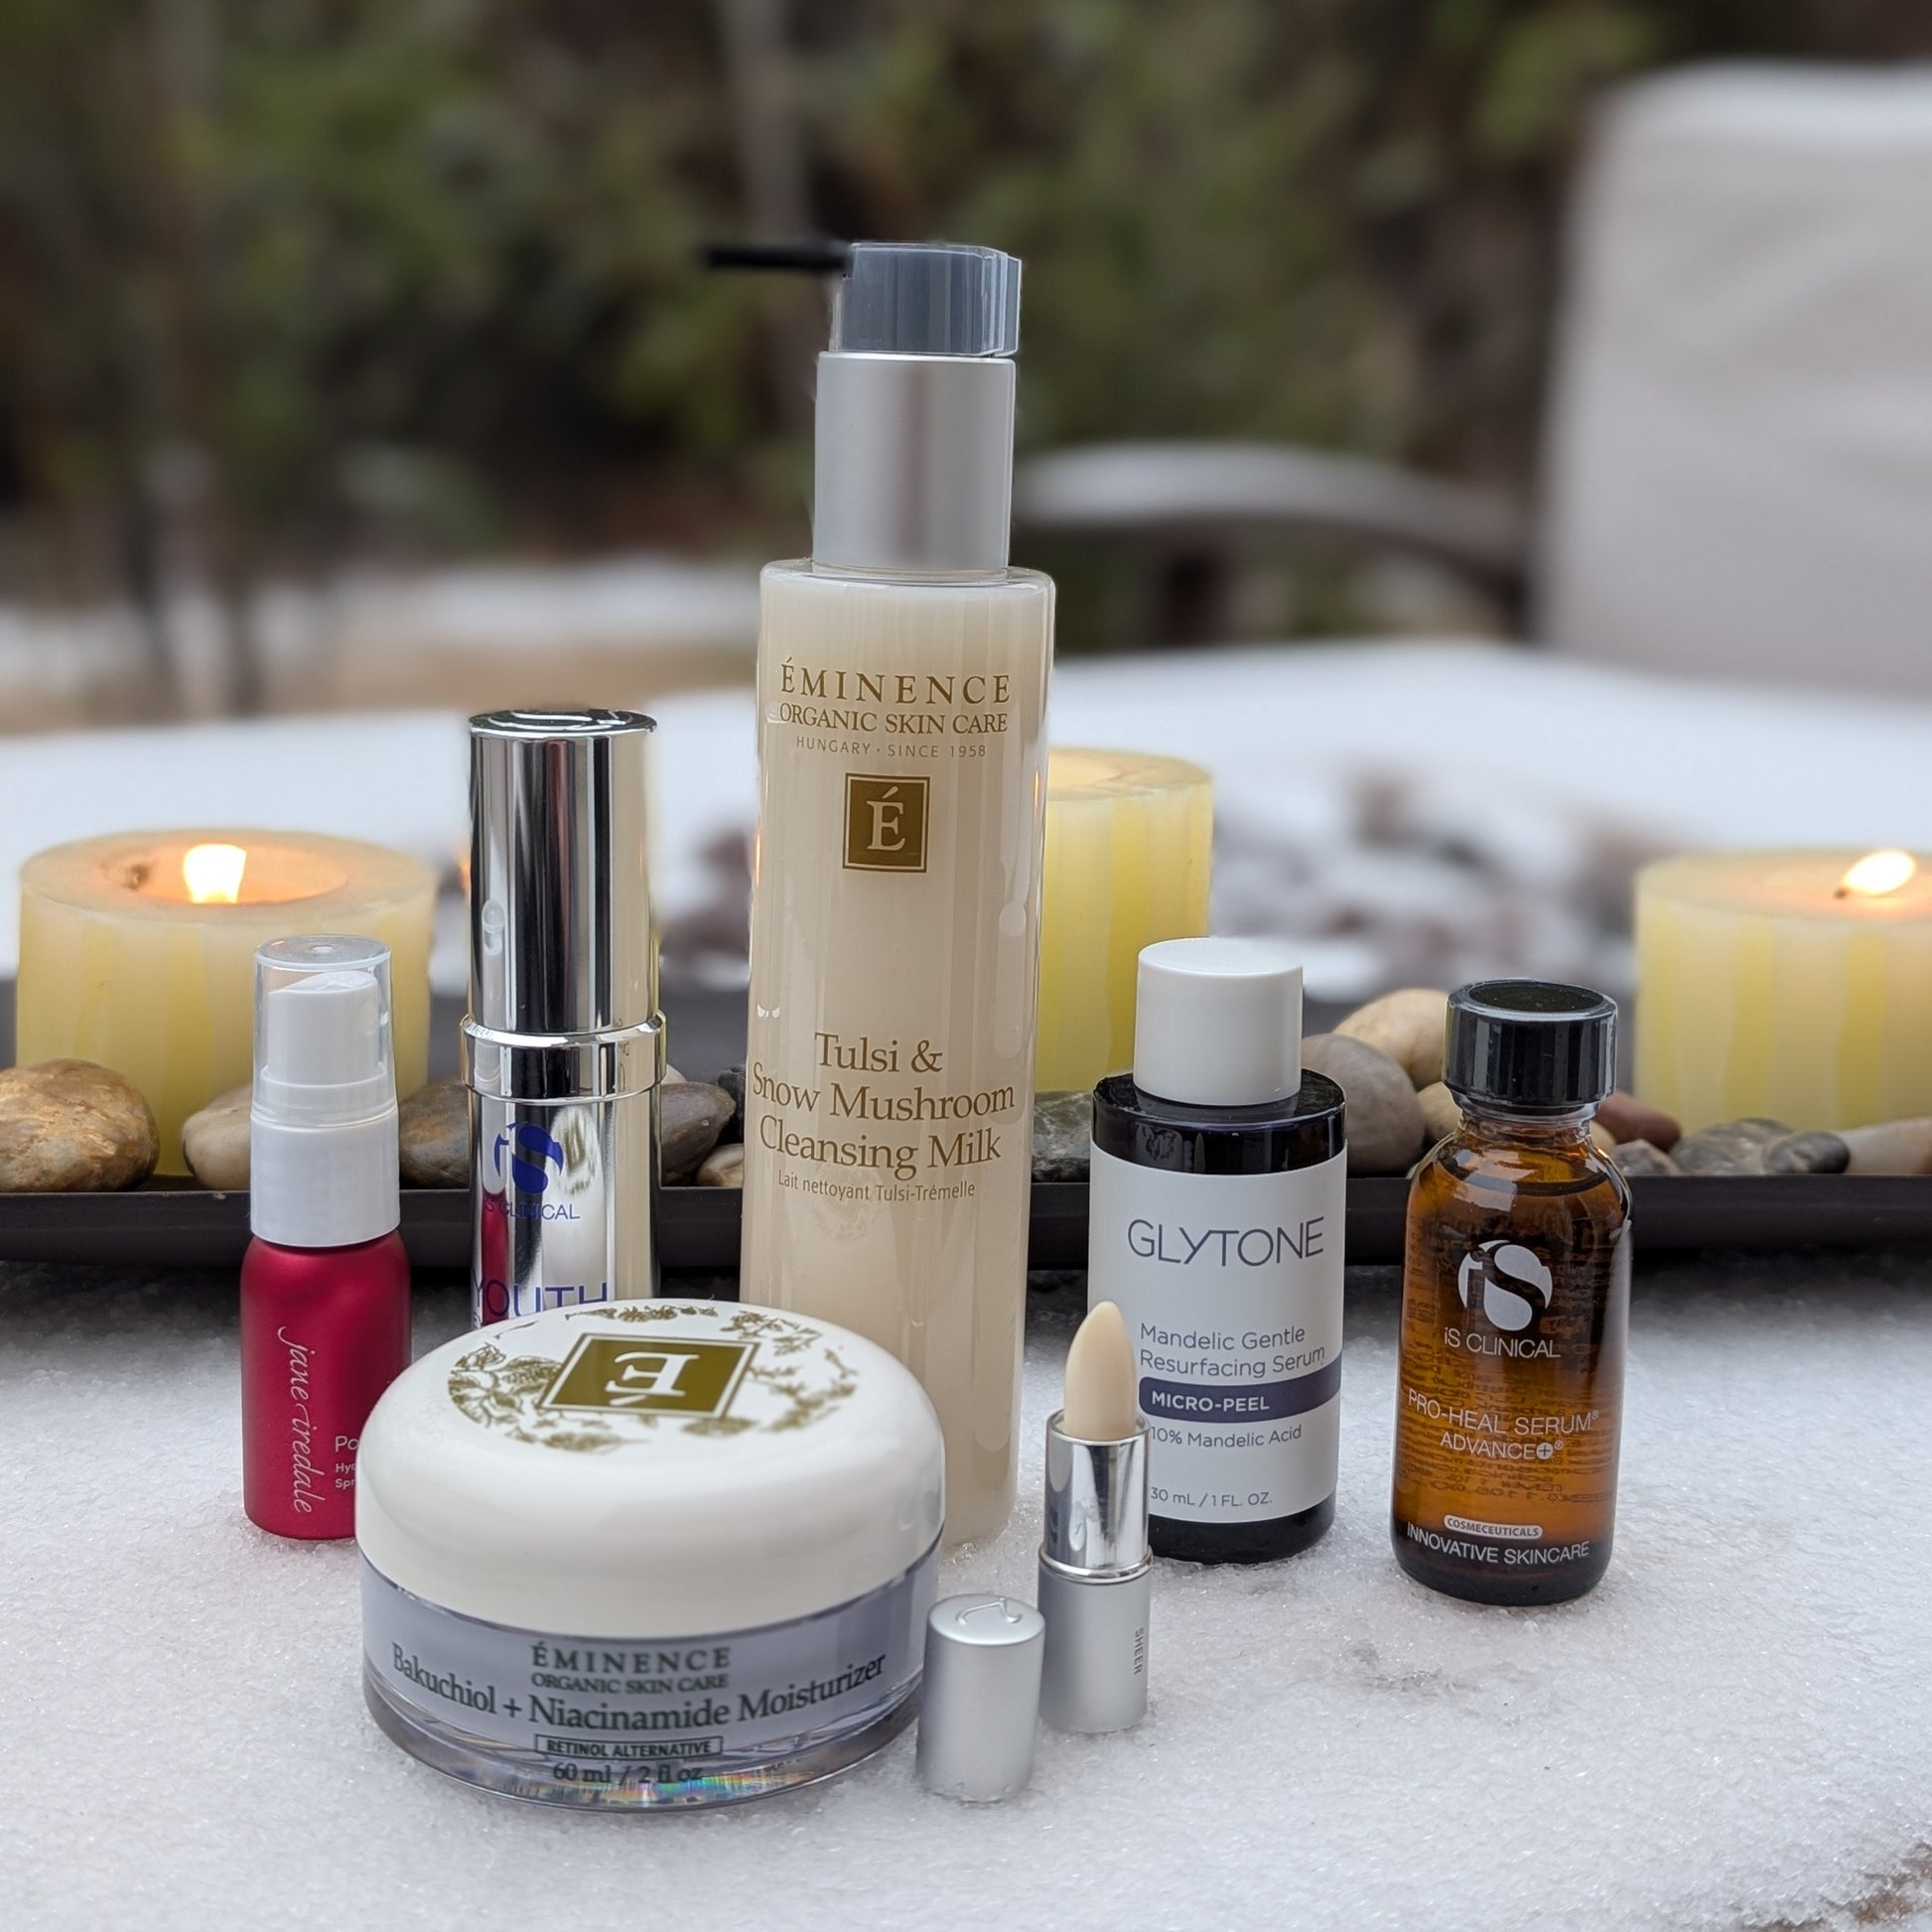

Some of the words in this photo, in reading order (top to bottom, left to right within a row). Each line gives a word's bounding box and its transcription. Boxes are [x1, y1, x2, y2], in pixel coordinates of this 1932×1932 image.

[780, 656, 1011, 704] ÉMINENCE
[779, 702, 878, 732] ORGANIC
[885, 713, 946, 735] SKIN
[952, 713, 1008, 735] CARE
[796, 735, 871, 755] HUNGARY
[888, 745, 938, 758] SINCE
[950, 745, 986, 758] 1958
[866, 785, 906, 852] É
[814, 1032, 900, 1072] Tulsi
[910, 1039, 943, 1073] &
[753, 1061, 821, 1112] Snow
[830, 1082, 1016, 1121] Mushroom
[759, 1115, 918, 1180] Cleansing
[926, 1127, 1002, 1168] Milk
[778, 1169, 799, 1189] Lait
[803, 1177, 870, 1201] nettoyant
[876, 1180, 976, 1202] Tulsi-Trémelle
[1128, 1216, 1324, 1267] GLYTONE
[1141, 1322, 1235, 1350] Mandelic
[1241, 1326, 1306, 1350] Gentle
[1445, 1326, 1461, 1348] iS
[1466, 1333, 1562, 1359] CLINICAL
[277, 1325, 317, 1401] jane
[1141, 1349, 1266, 1378] Resurfacing
[1273, 1345, 1325, 1373] Serum
[1151, 1390, 1270, 1413] MICRO-PEEL
[1408, 1387, 1507, 1435] PRO-HEAL
[1151, 1426, 1182, 1446] 10%
[1187, 1432, 1265, 1449] Mandelic
[1269, 1425, 1303, 1445] Acid
[292, 1403, 326, 1514] iredale
[1151, 1487, 1169, 1502] 30
[1173, 1493, 1195, 1506] mL
[1198, 1493, 1208, 1507] /
[1212, 1495, 1217, 1506] 1
[1407, 1522, 1498, 1564] INNOVATIVE
[1504, 1541, 1590, 1565] SKINCARE
[1447, 1517, 1540, 1538] COSMECEUTICALS
[530, 1641, 731, 1675] ÉMINENCE
[1133, 1627, 1145, 1675] SHEER
[392, 1642, 497, 1715] Bakuchiol
[503, 1698, 522, 1719] +
[528, 1694, 731, 1730] Niacinamide
[737, 1654, 886, 1723] Moisturizer
[531, 1672, 621, 1694] ORGANIC
[625, 1675, 672, 1695] SKIN
[678, 1674, 730, 1693] CARE
[547, 1739, 610, 1757] RETINOL
[613, 1738, 711, 1757] ALTERNATIVE
[553, 1762, 578, 1781] 60
[583, 1765, 611, 1783] ml
